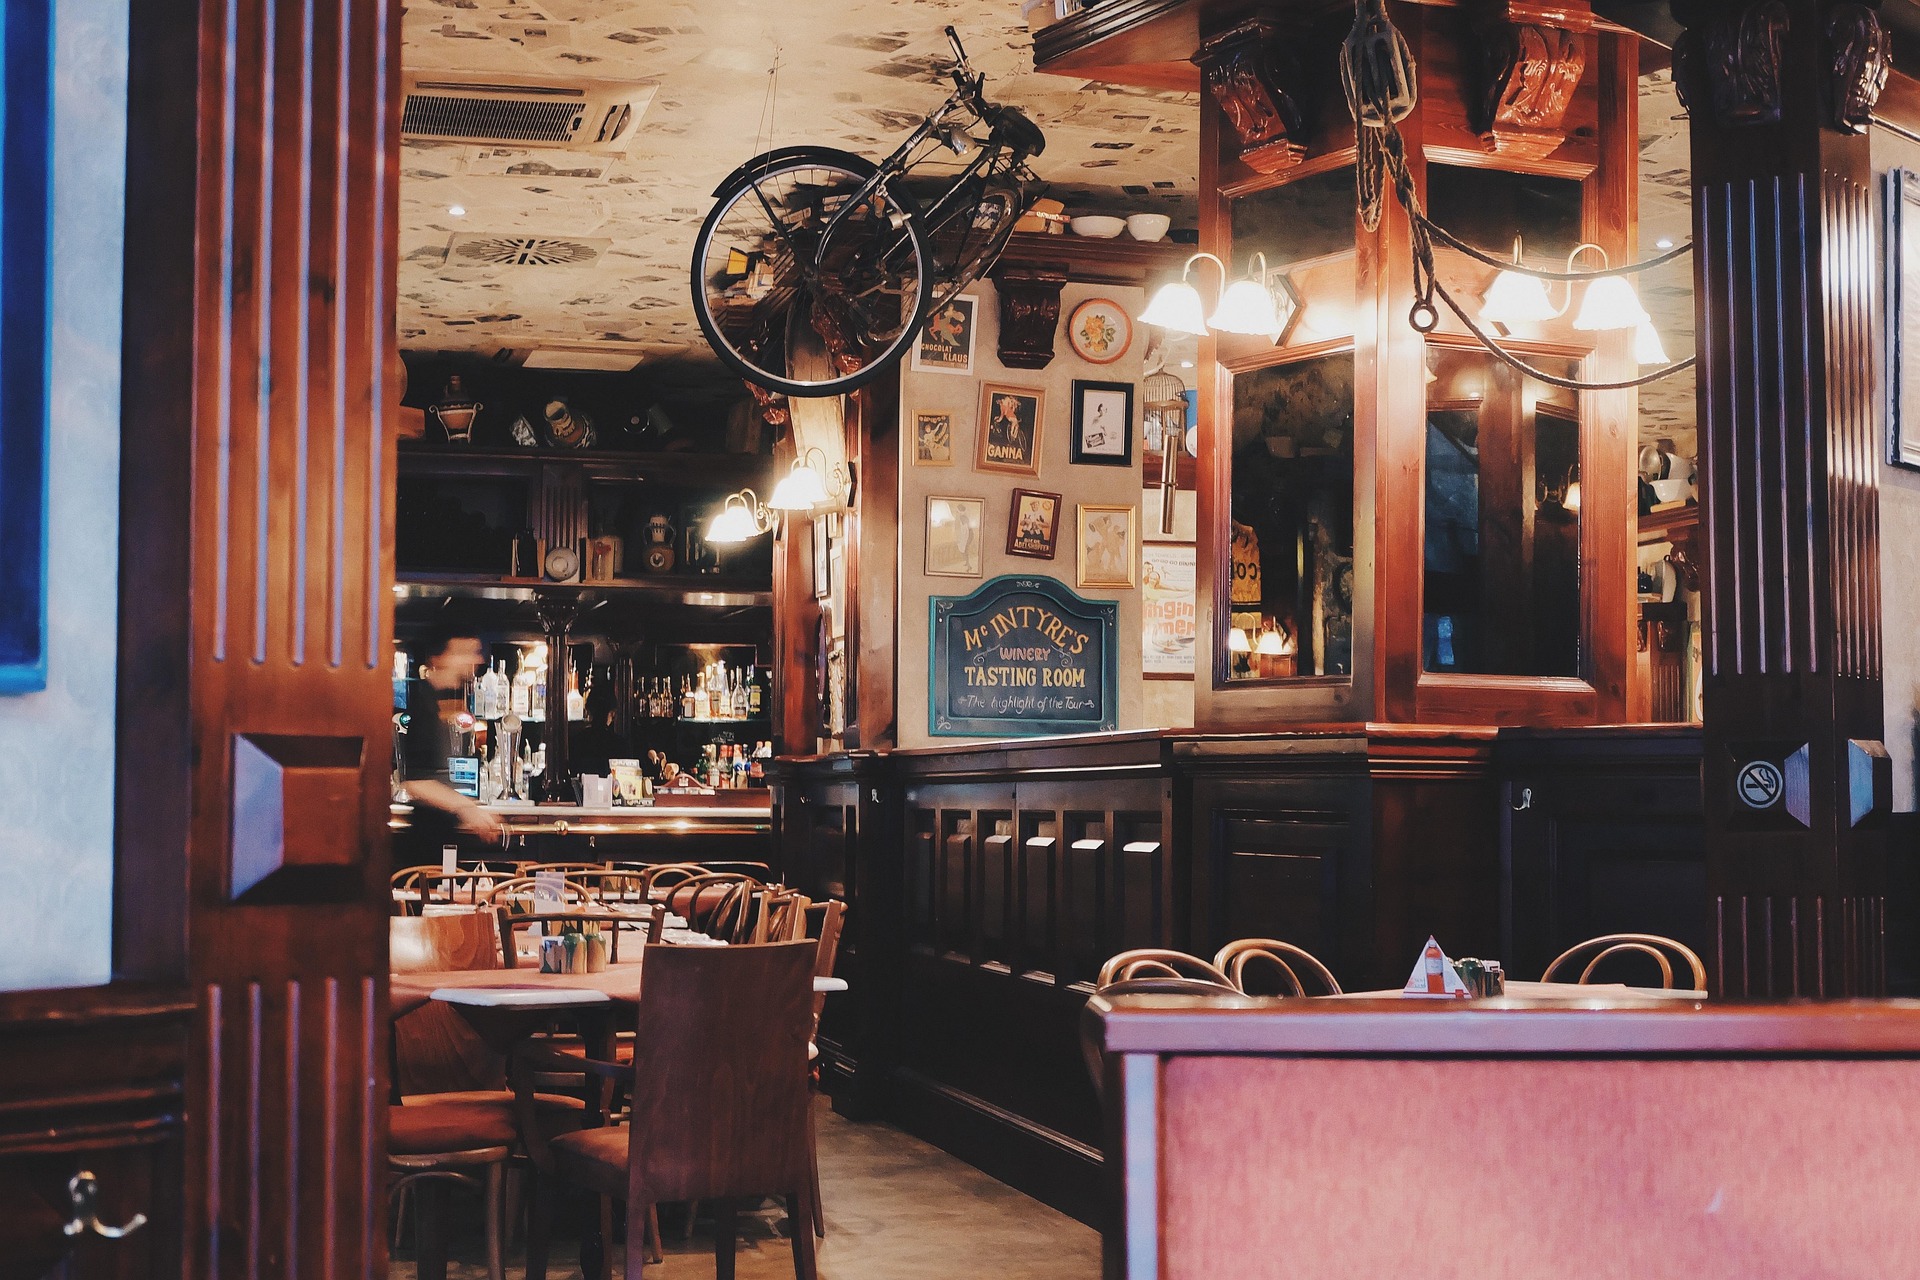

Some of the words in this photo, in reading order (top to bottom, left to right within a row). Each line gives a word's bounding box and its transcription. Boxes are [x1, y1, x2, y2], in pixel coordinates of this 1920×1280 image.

[943, 352, 968, 363] KLAUS
[987, 444, 1023, 460] GANNA
[1143, 601, 1194, 620] ingin
[999, 647, 1051, 661] WINERY
[964, 666, 1037, 687] TASTING
[1042, 667, 1086, 688] ROOM
[967, 694, 986, 709] The
[991, 694, 1035, 714] highlight
[1037, 695, 1048, 713] of
[1048, 694, 1063, 709] the
[1064, 695, 1085, 710] Tour
